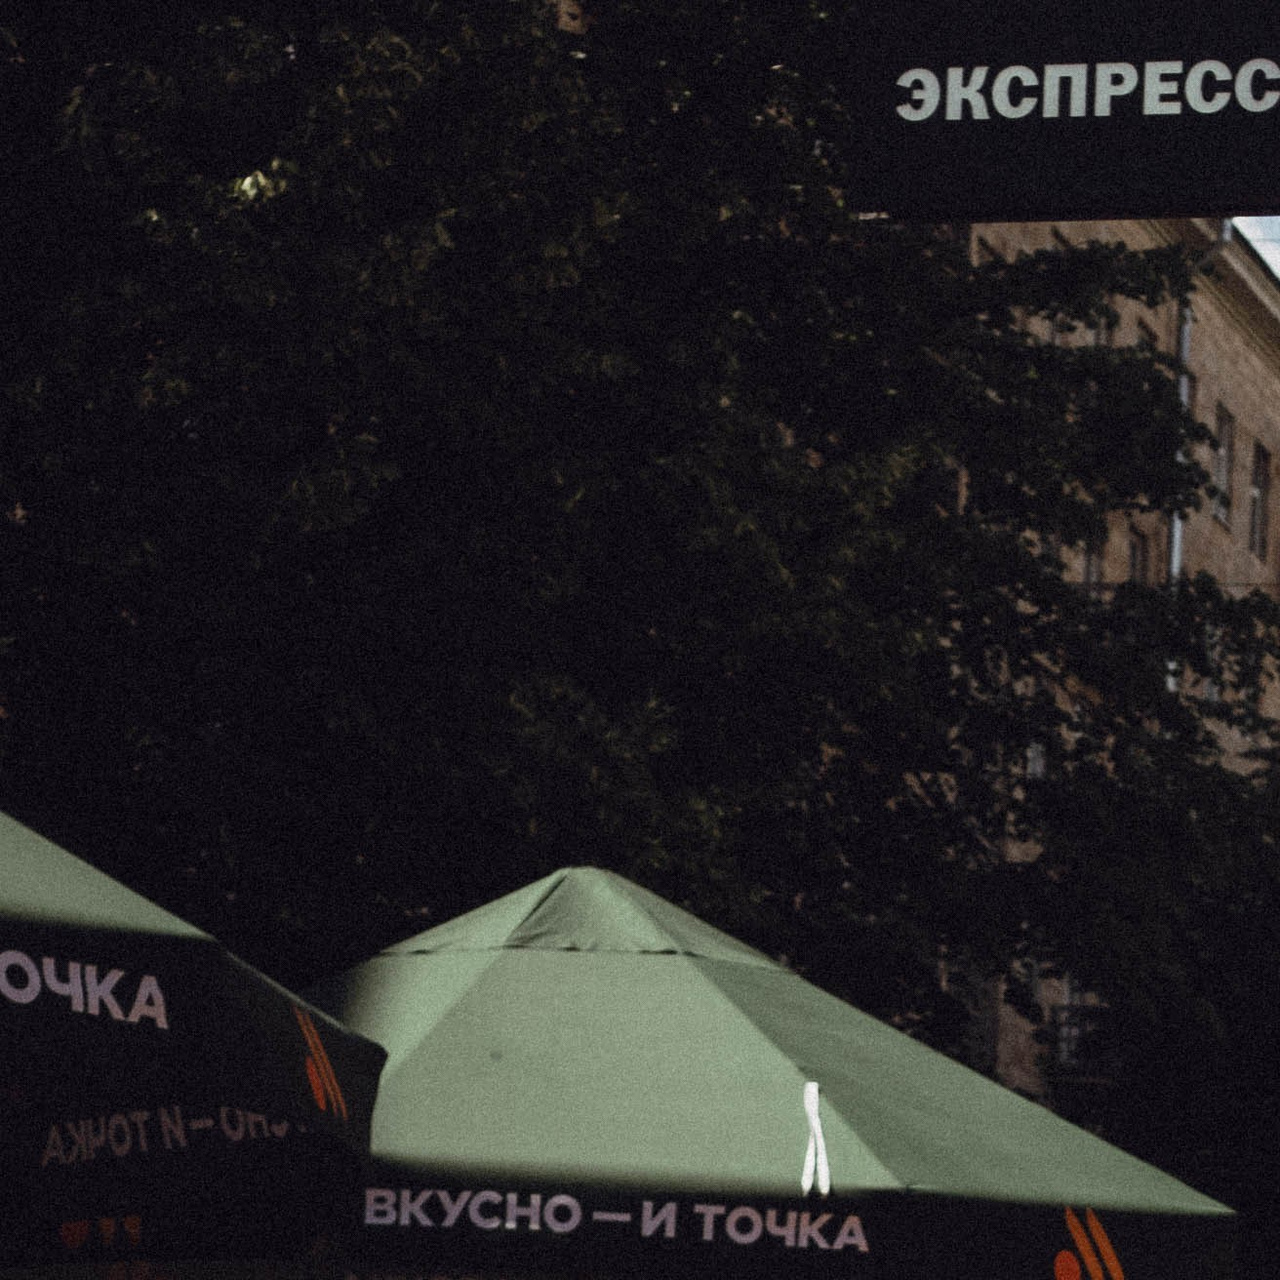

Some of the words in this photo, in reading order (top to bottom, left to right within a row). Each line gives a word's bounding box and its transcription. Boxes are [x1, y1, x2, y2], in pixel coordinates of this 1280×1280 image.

[363, 1187, 582, 1233] ВКУСНО
[640, 1200, 678, 1238] И
[694, 1203, 870, 1253] ТОЧКА
